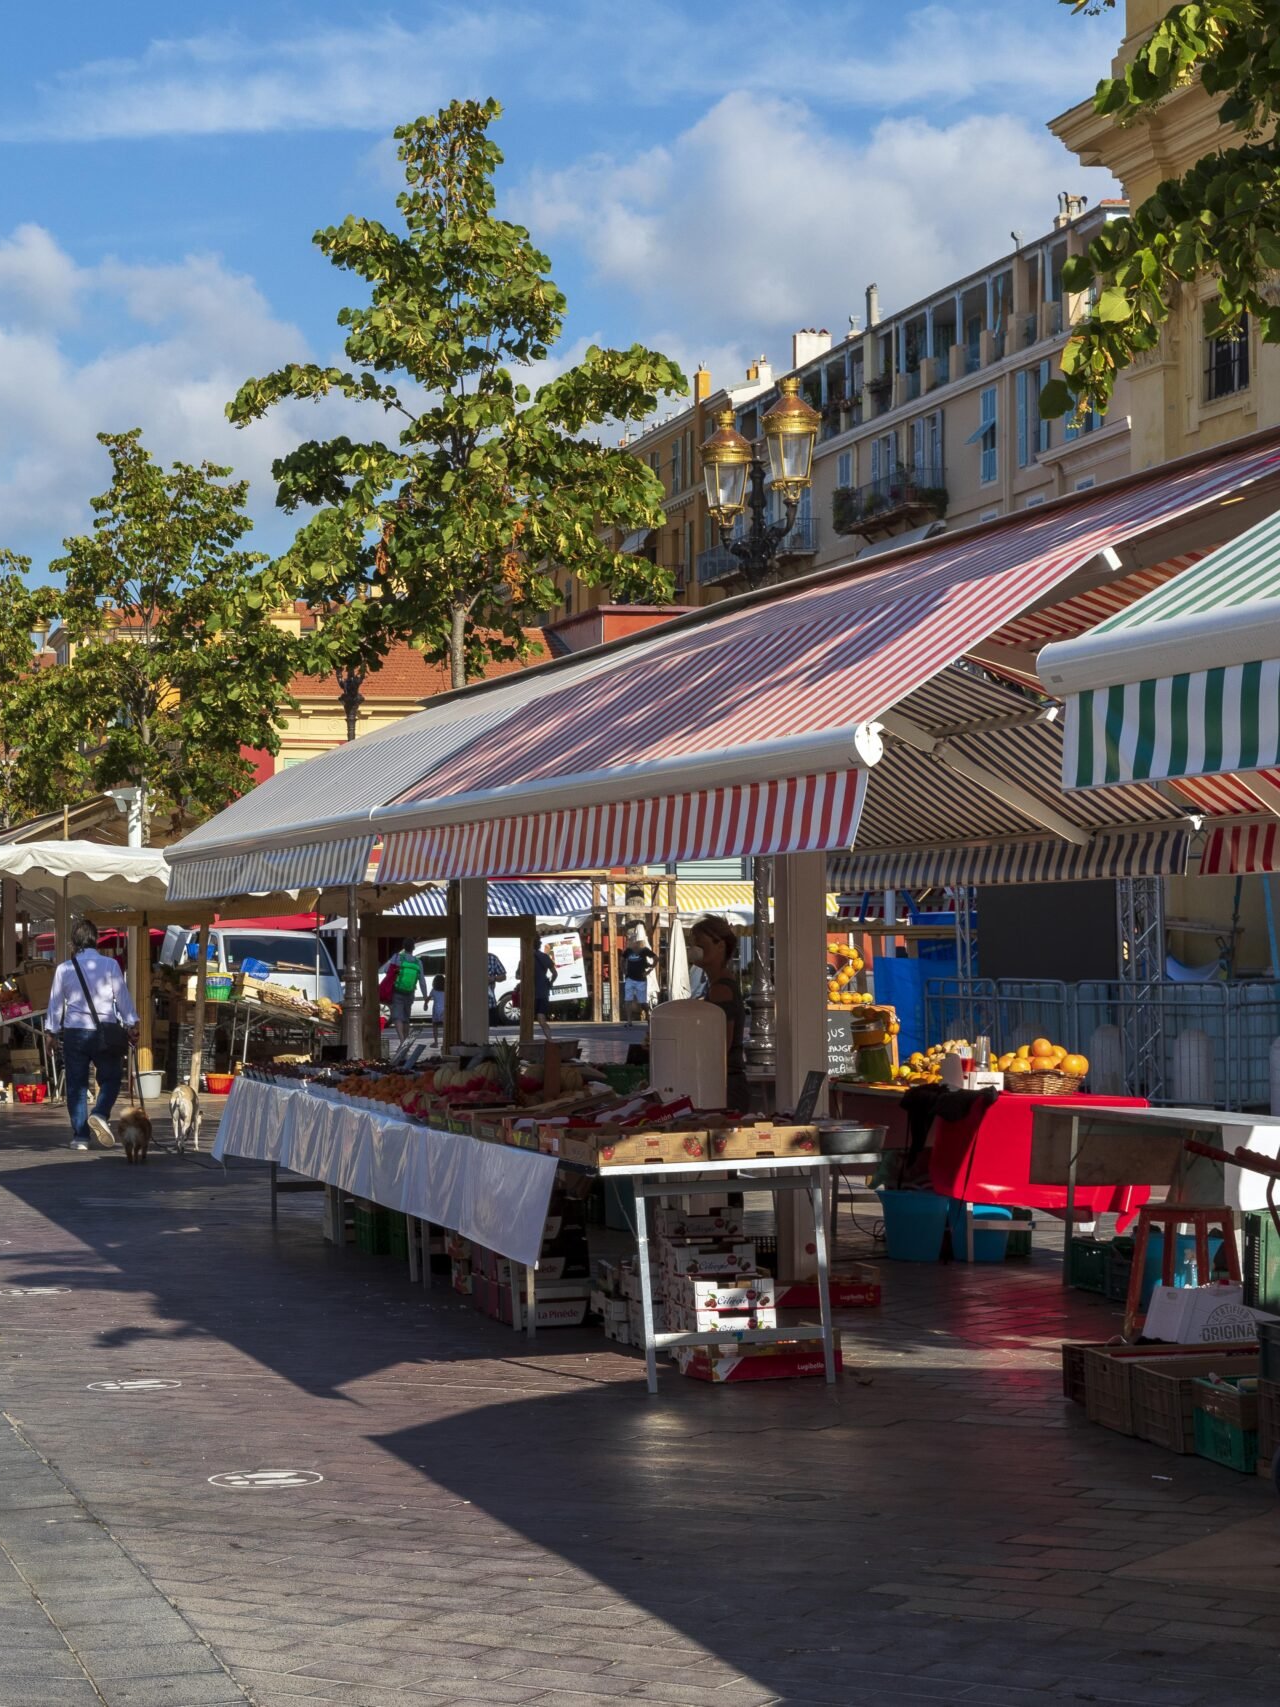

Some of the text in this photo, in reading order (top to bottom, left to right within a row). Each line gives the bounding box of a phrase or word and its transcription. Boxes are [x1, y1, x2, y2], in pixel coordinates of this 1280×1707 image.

[827, 1028, 845, 1042] JUS
[827, 1044, 853, 1053] ANGE
[538, 1311, 548, 1320] La
[1211, 1304, 1251, 1321] CERTIFIED
[1202, 1323, 1255, 1341] ORIGINA
